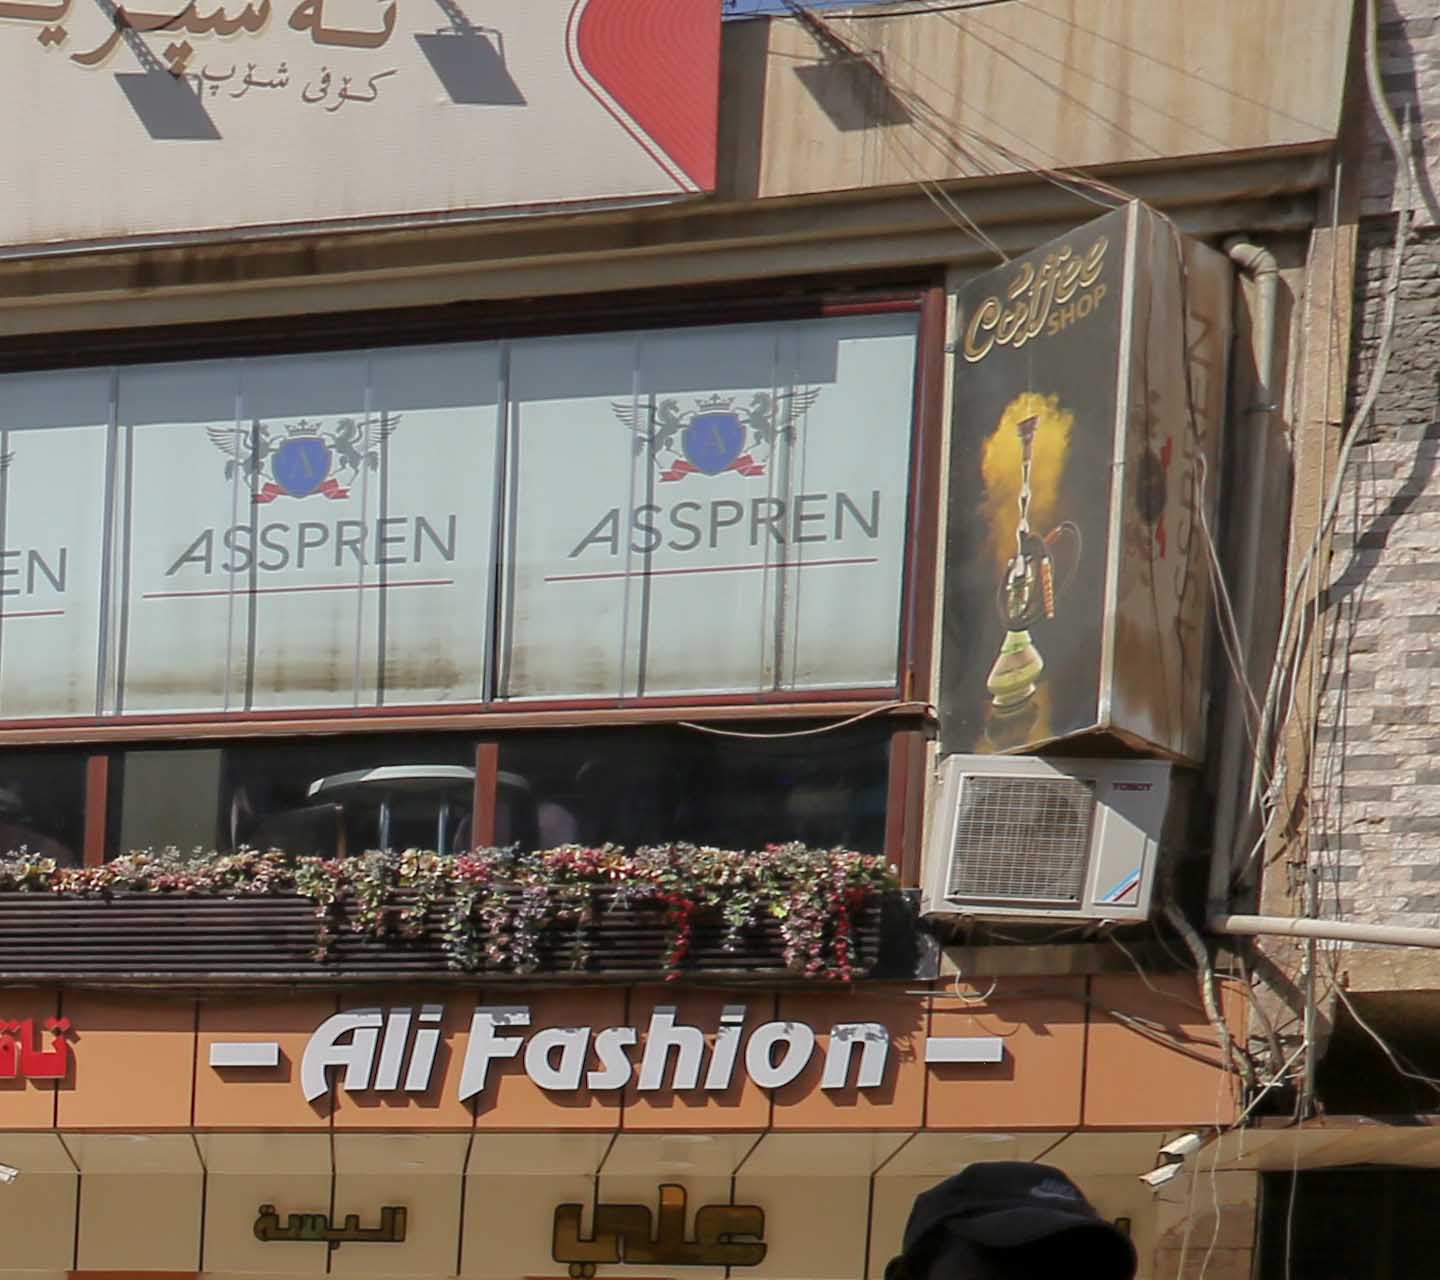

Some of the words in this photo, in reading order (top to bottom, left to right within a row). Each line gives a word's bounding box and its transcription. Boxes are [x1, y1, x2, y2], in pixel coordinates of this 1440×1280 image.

[964, 237, 1108, 362] Coffee
[1046, 283, 1107, 336] SHOP
[165, 514, 458, 578] ASSPREN
[567, 491, 881, 559] ASSPREN
[300, 1004, 446, 1104] Ali
[458, 1003, 890, 1103] Fashion
[552, 1184, 768, 1280] علي
